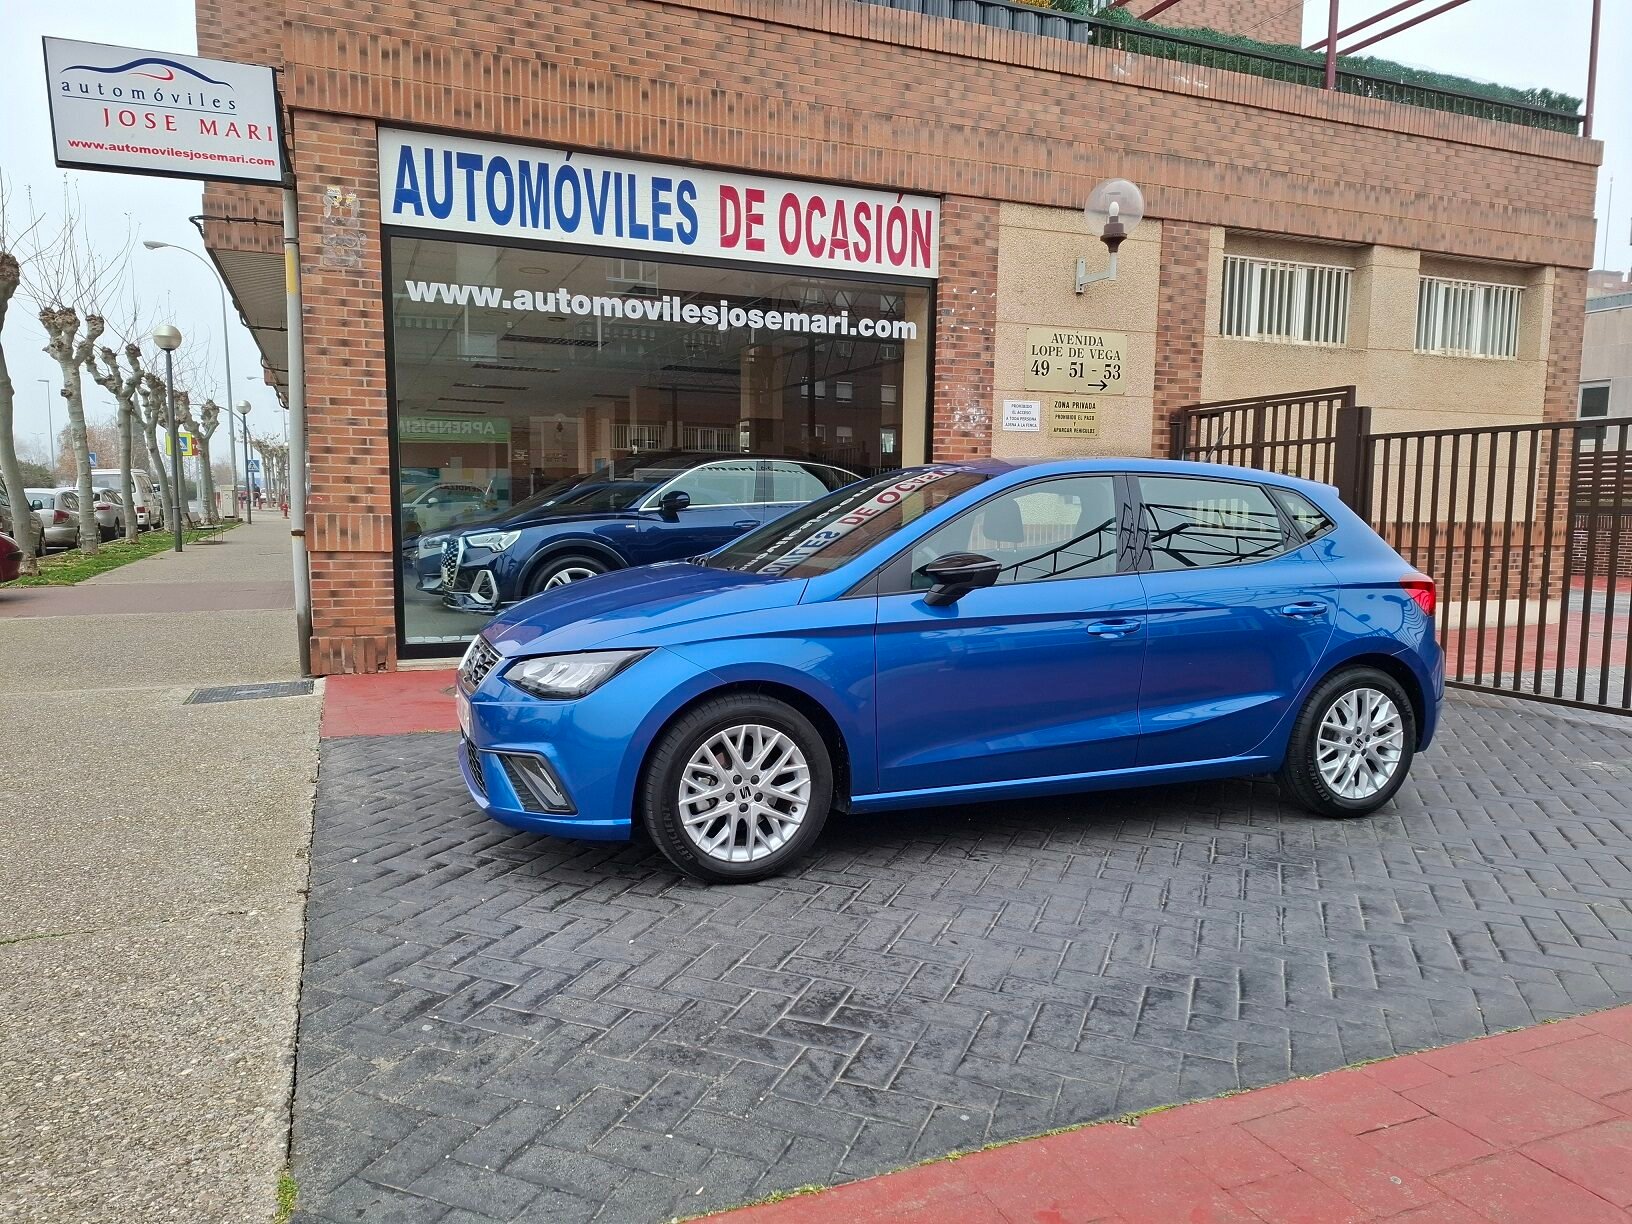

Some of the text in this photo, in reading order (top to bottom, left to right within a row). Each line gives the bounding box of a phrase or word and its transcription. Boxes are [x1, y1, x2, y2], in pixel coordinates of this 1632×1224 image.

[62, 81, 236, 109] automóviles
[103, 108, 273, 141] JOSE MARI
[68, 138, 275, 166] www.automovilesjosemari.com
[392, 144, 932, 269] AUTOMÓVILES DE OCASIÓN
[405, 280, 917, 340] www.automovilesjosemari.com
[1031, 345, 1121, 360] LOPE DE VEGA
[1051, 333, 1104, 347] AVENIDA
[1031, 360, 1050, 376] 49
[1069, 361, 1084, 378] 51
[1103, 363, 1121, 380] 53
[1054, 401, 1096, 410] ZONA PRIVADA
